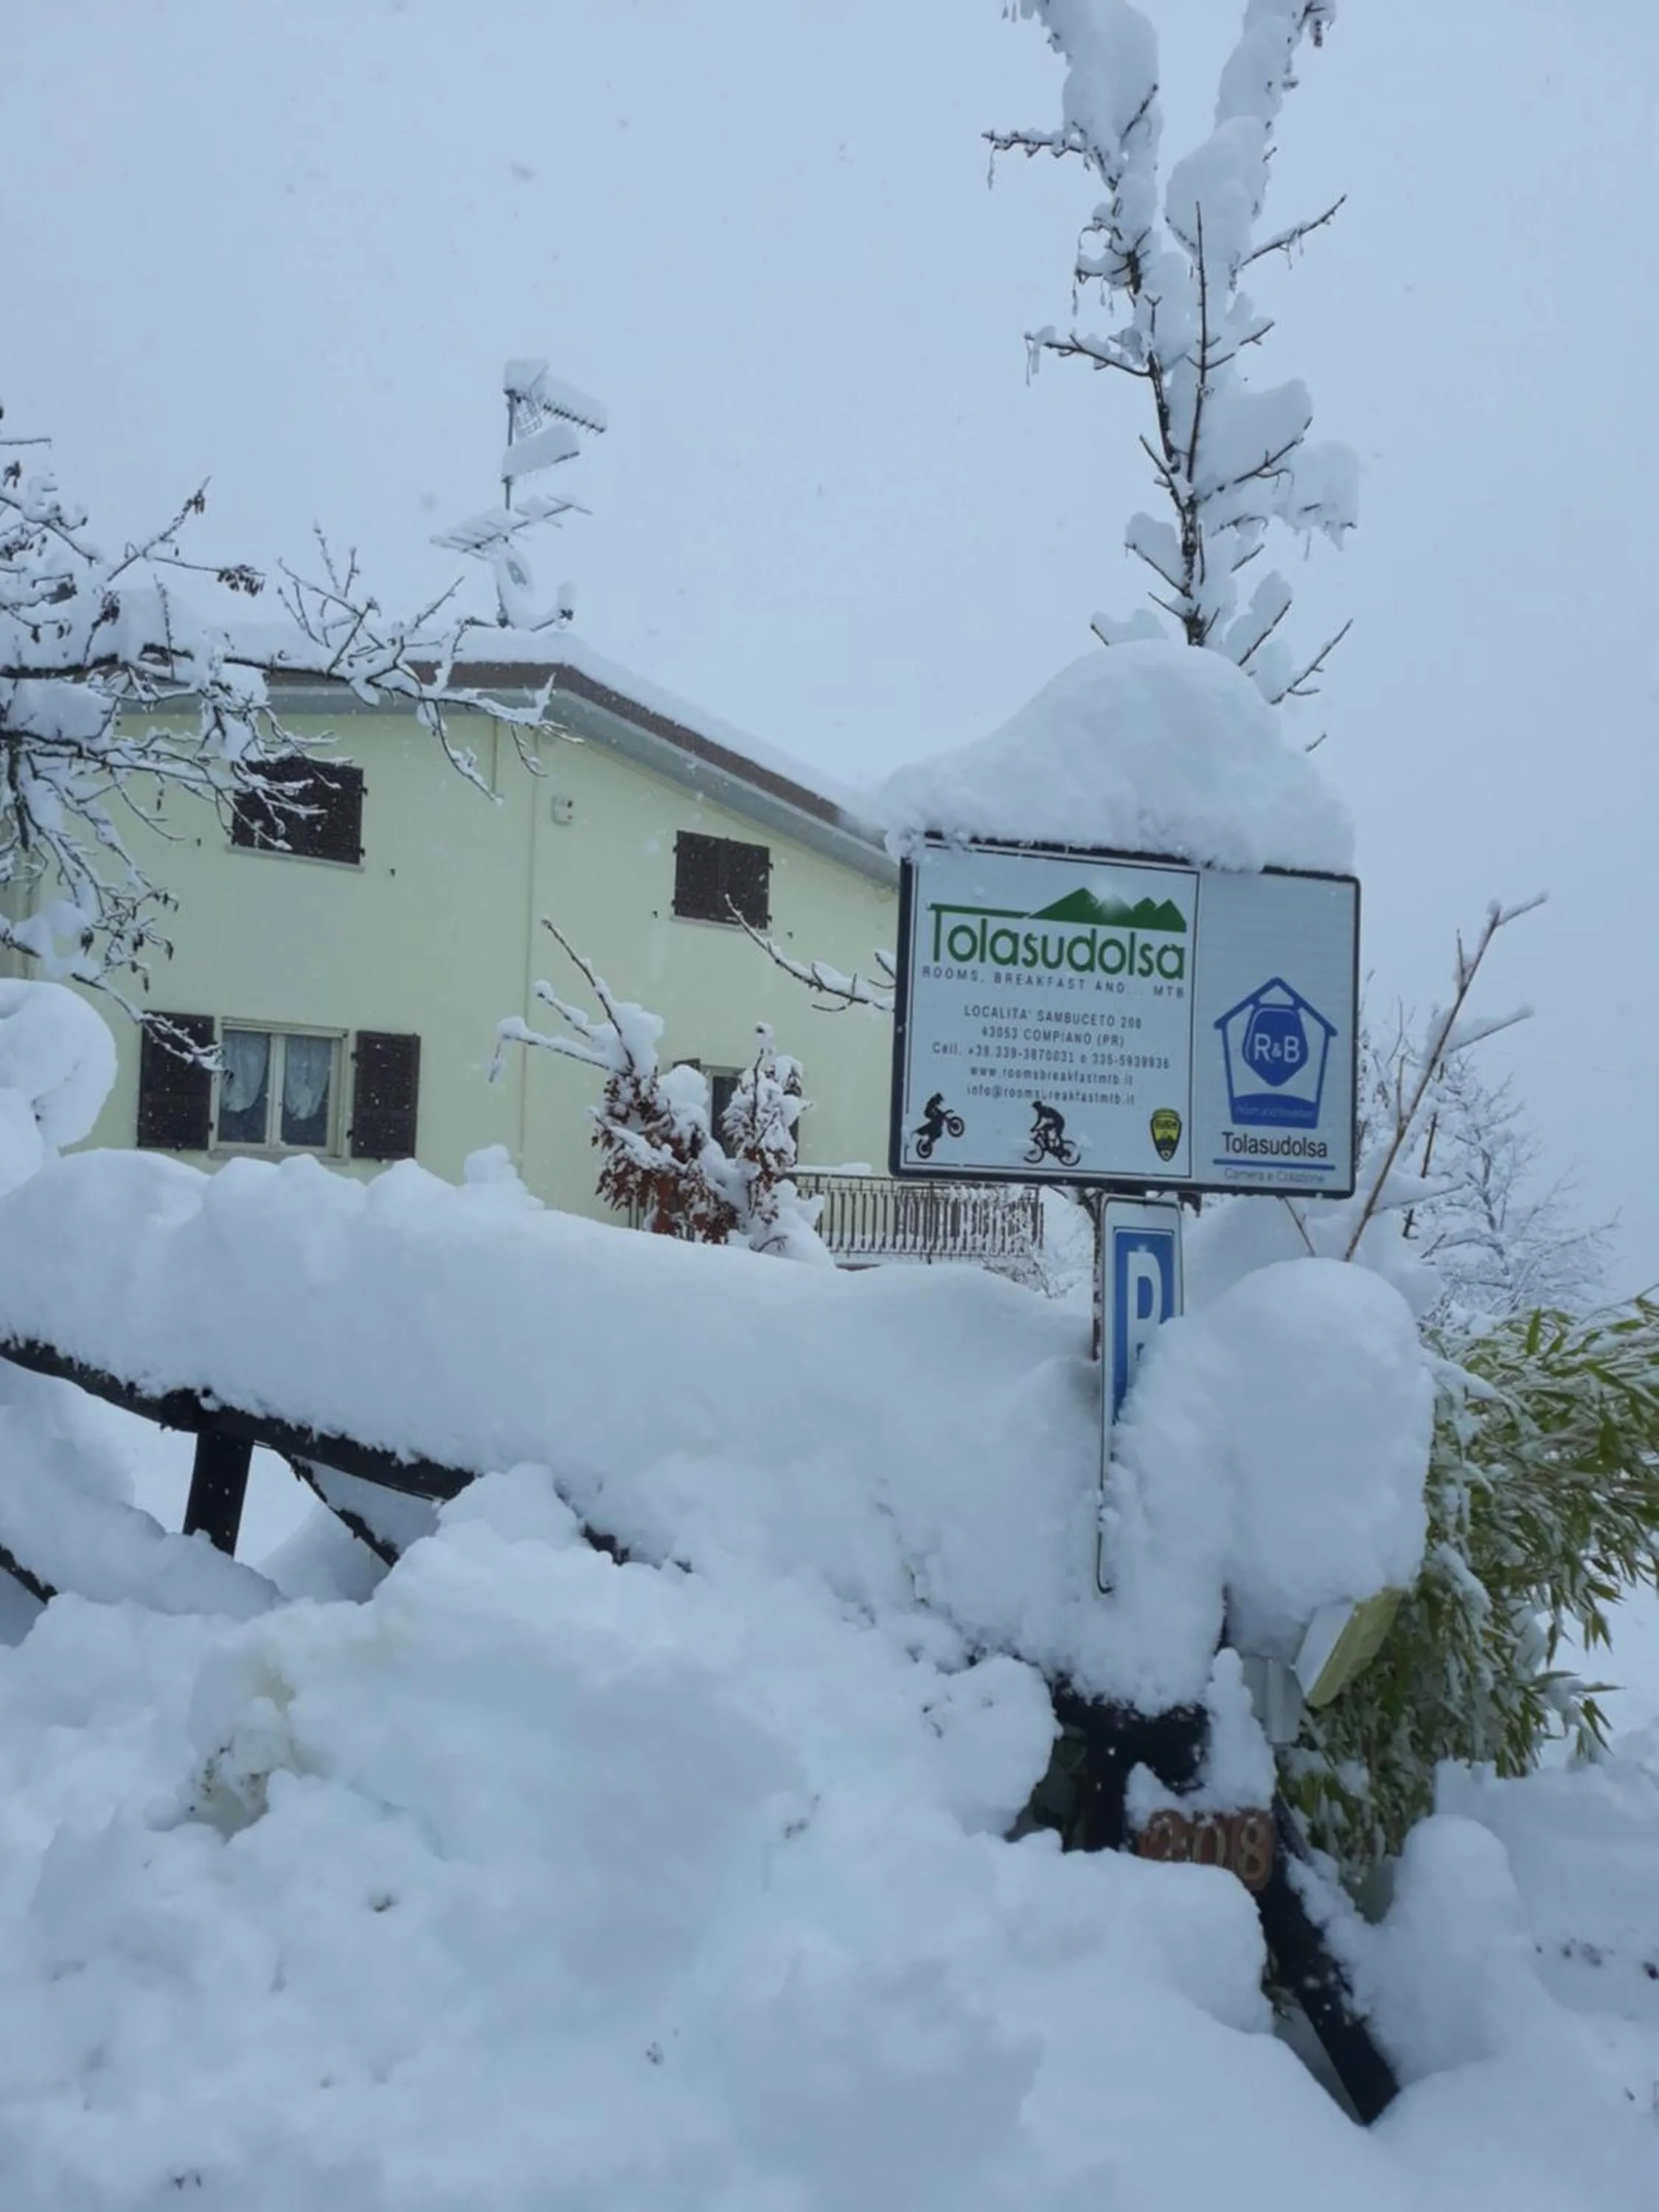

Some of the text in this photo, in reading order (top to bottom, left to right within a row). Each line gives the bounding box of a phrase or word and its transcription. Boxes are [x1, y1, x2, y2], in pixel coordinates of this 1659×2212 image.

[923, 901, 1186, 981] Tolasudolsa
[993, 971, 1085, 991] BREAKFAST
[1153, 984, 1185, 999] MTB
[964, 1004, 1143, 1030] LOCALITA' SAMBUCETO 208
[1023, 1028, 1093, 1046] COMPIANO
[1096, 1033, 1125, 1049] (PR)
[1254, 1032, 1301, 1063] R&B
[967, 1084, 1135, 1106] info@roomsreakfastmtb.it
[1221, 1130, 1329, 1158] Tolasudolsa
[1127, 1251, 1163, 1389] P
